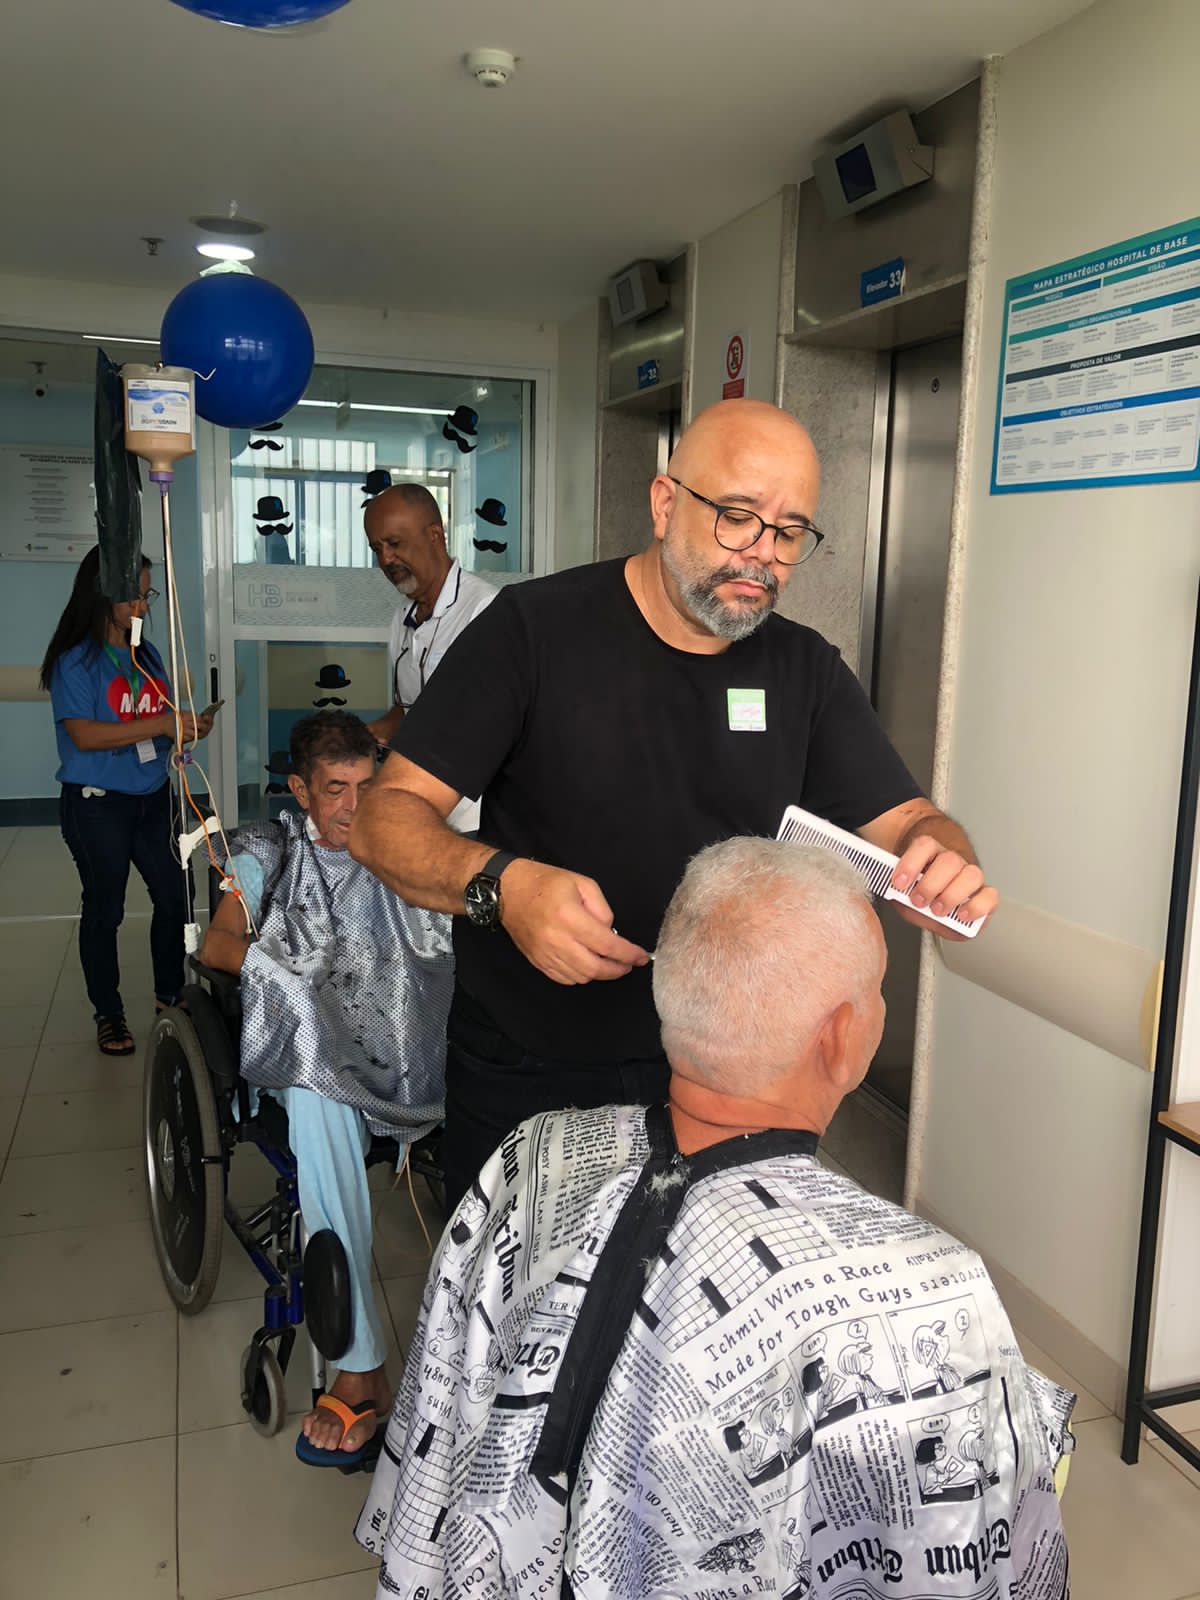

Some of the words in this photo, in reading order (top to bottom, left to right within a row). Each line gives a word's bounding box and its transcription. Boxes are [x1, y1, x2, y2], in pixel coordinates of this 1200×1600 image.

[1033, 278, 1052, 290] MAPA
[1055, 263, 1105, 284] ESTRATÉGICO
[1107, 251, 1147, 268] HOSPITAL
[1150, 245, 1161, 255] DE
[1164, 236, 1188, 250] BASE
[1070, 358, 1095, 369] PROPOSTA
[1104, 353, 1121, 363] VALOR
[704, 1308, 765, 1362] Tchmil
[765, 1278, 815, 1312] Wins
[823, 1273, 836, 1285] a
[838, 1260, 892, 1281] Race
[705, 1353, 754, 1395] Made
[758, 1330, 784, 1363] for
[785, 1293, 851, 1331] Tough
[858, 1286, 912, 1305] Guys
[423, 1363, 459, 1396] Tough
[646, 1490, 661, 1507] on
[1033, 1476, 1056, 1493] Ma
[661, 1507, 685, 1537] then
[816, 1536, 903, 1584] Tribun
